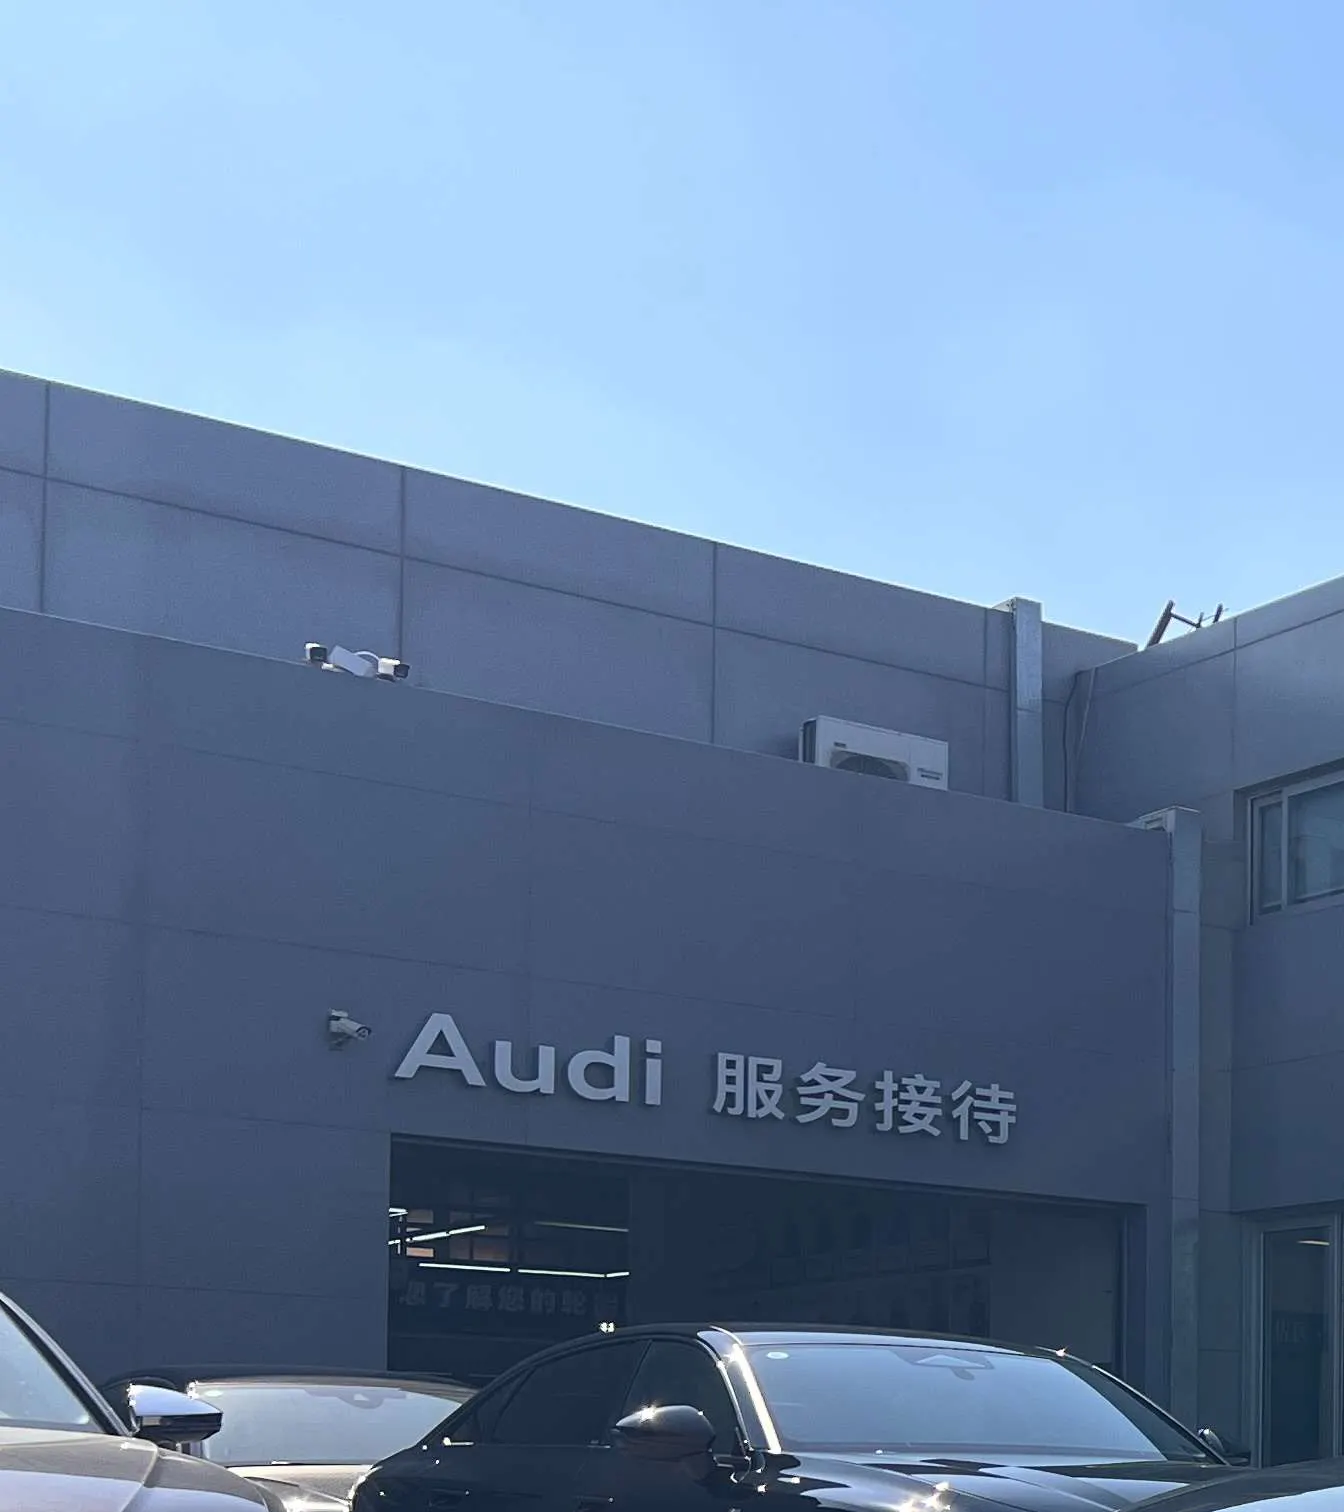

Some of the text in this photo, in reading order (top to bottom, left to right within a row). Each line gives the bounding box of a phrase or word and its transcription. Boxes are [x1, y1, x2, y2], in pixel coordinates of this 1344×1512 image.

[394, 1012, 1018, 1145] Audi 服务接待
